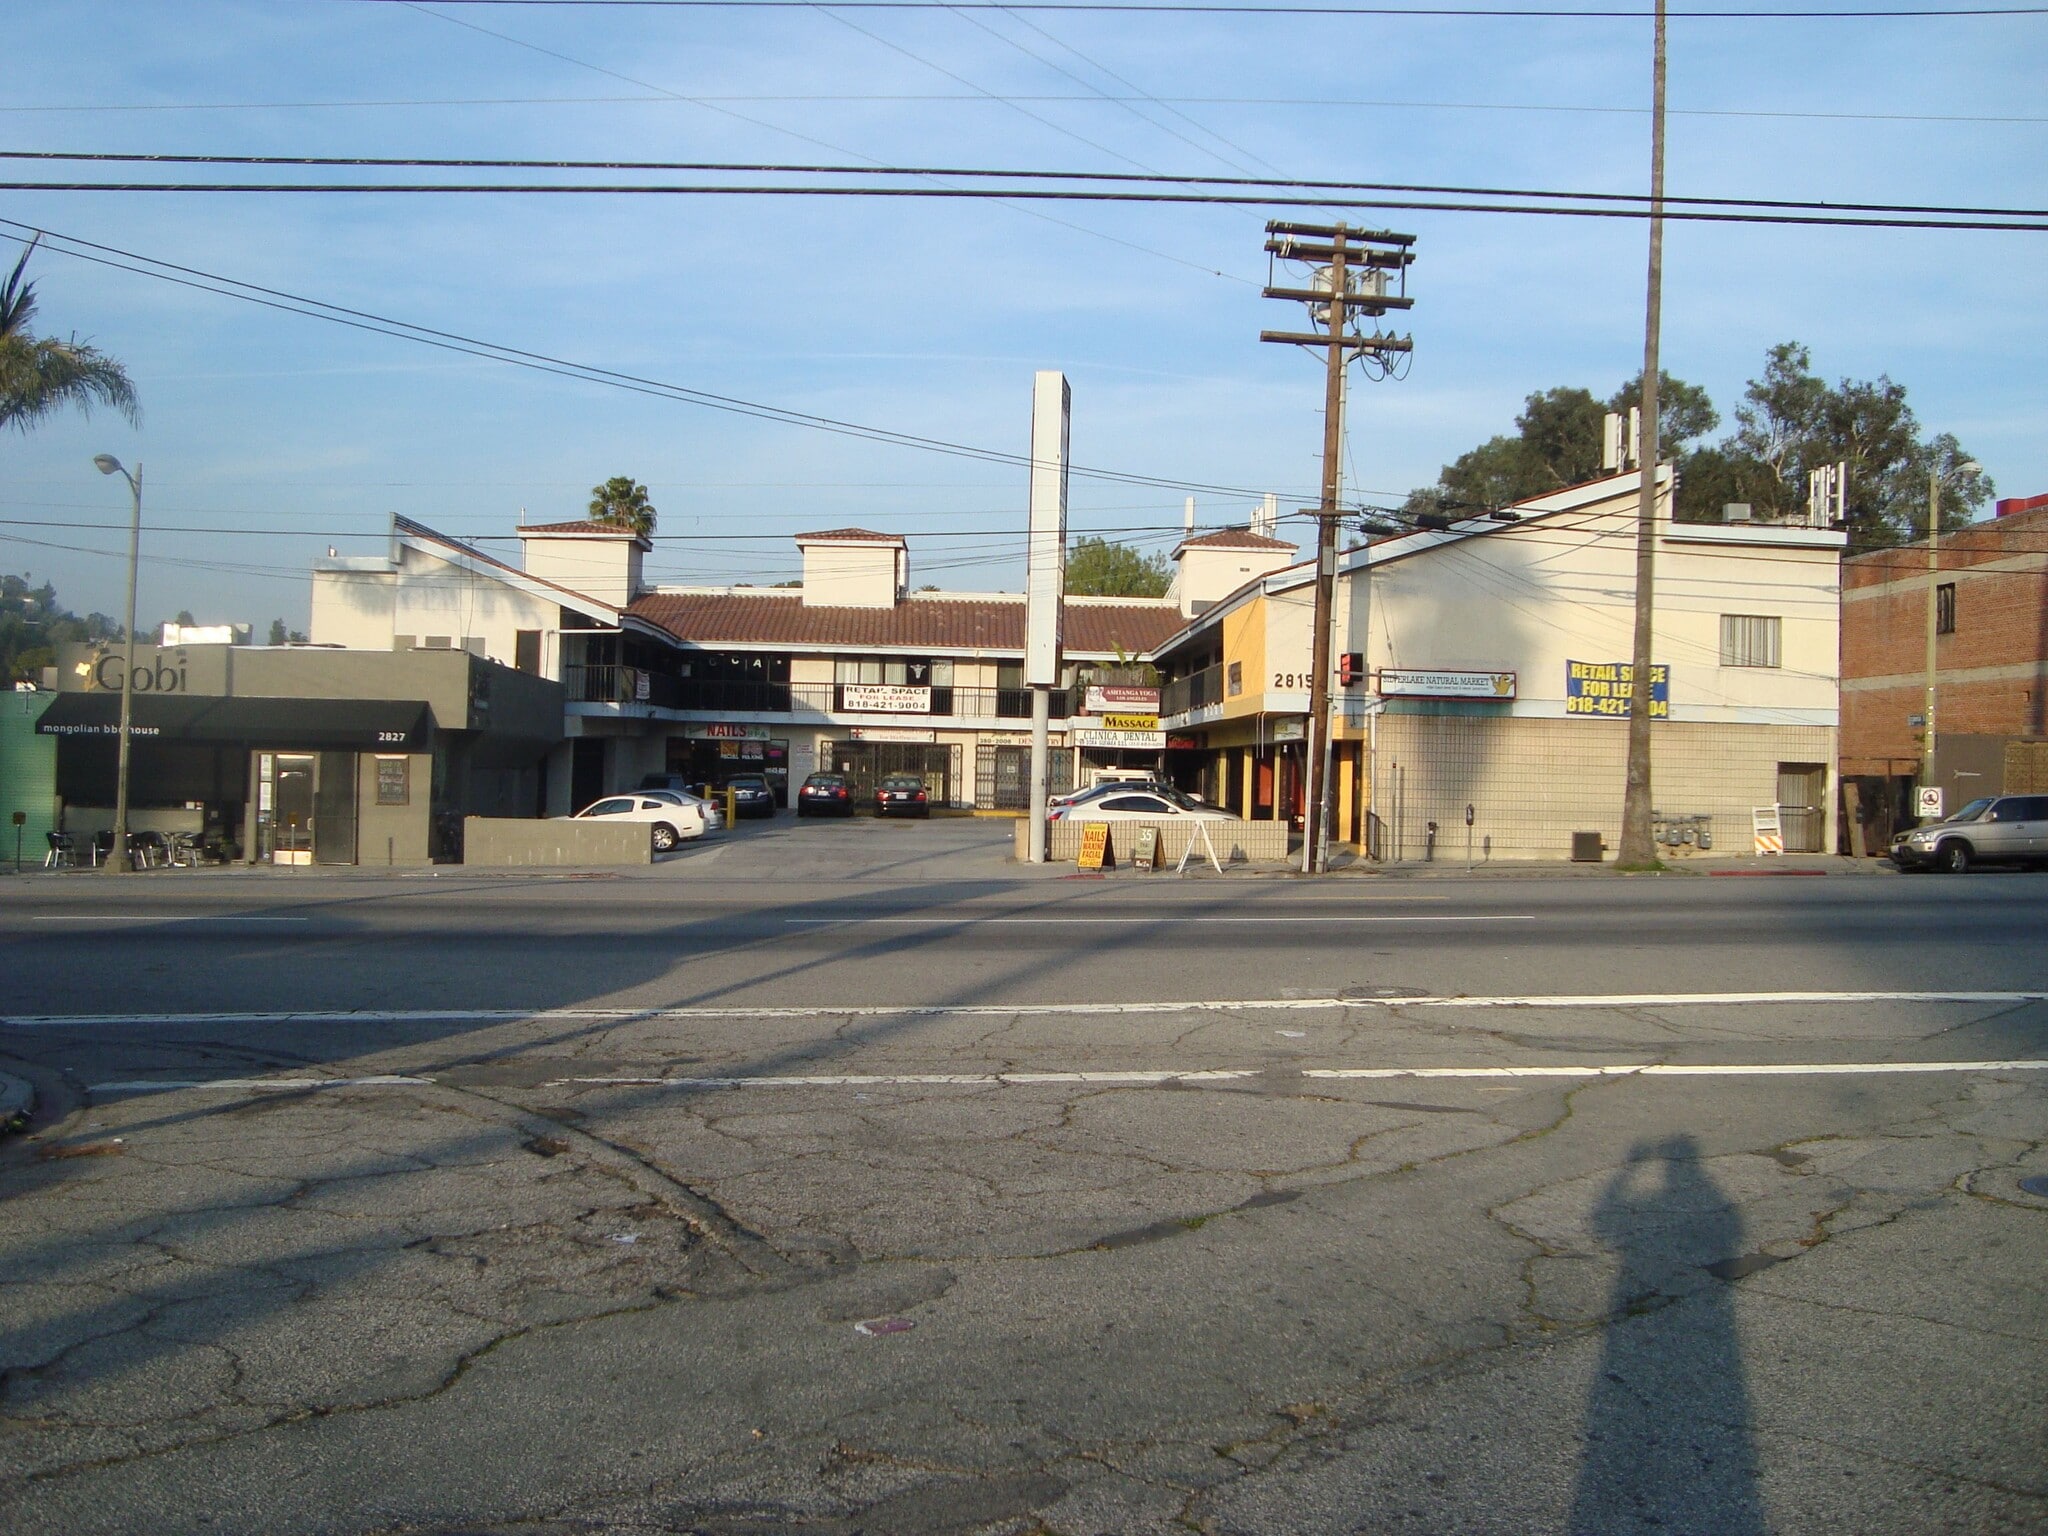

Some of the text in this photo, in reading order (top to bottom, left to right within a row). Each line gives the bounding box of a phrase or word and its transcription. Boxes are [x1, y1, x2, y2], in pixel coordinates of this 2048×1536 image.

[97, 654, 186, 692] Gobi
[1570, 662, 1666, 683] RETAIL SCE
[1274, 673, 1312, 688] 2815
[1426, 676, 1459, 686] NATURAL
[1460, 677, 1489, 686] MARKET
[891, 687, 929, 695] SPACE
[1582, 680, 1610, 697] FOR
[1567, 696, 1668, 716] 818-421-04
[43, 724, 100, 735] mongolian
[707, 723, 747, 737] NAILS
[378, 732, 406, 742] 2827
[1083, 731, 1157, 742] CLINICA DENTAL
[1084, 830, 1105, 842] NAILS
[1140, 829, 1153, 841] 35
